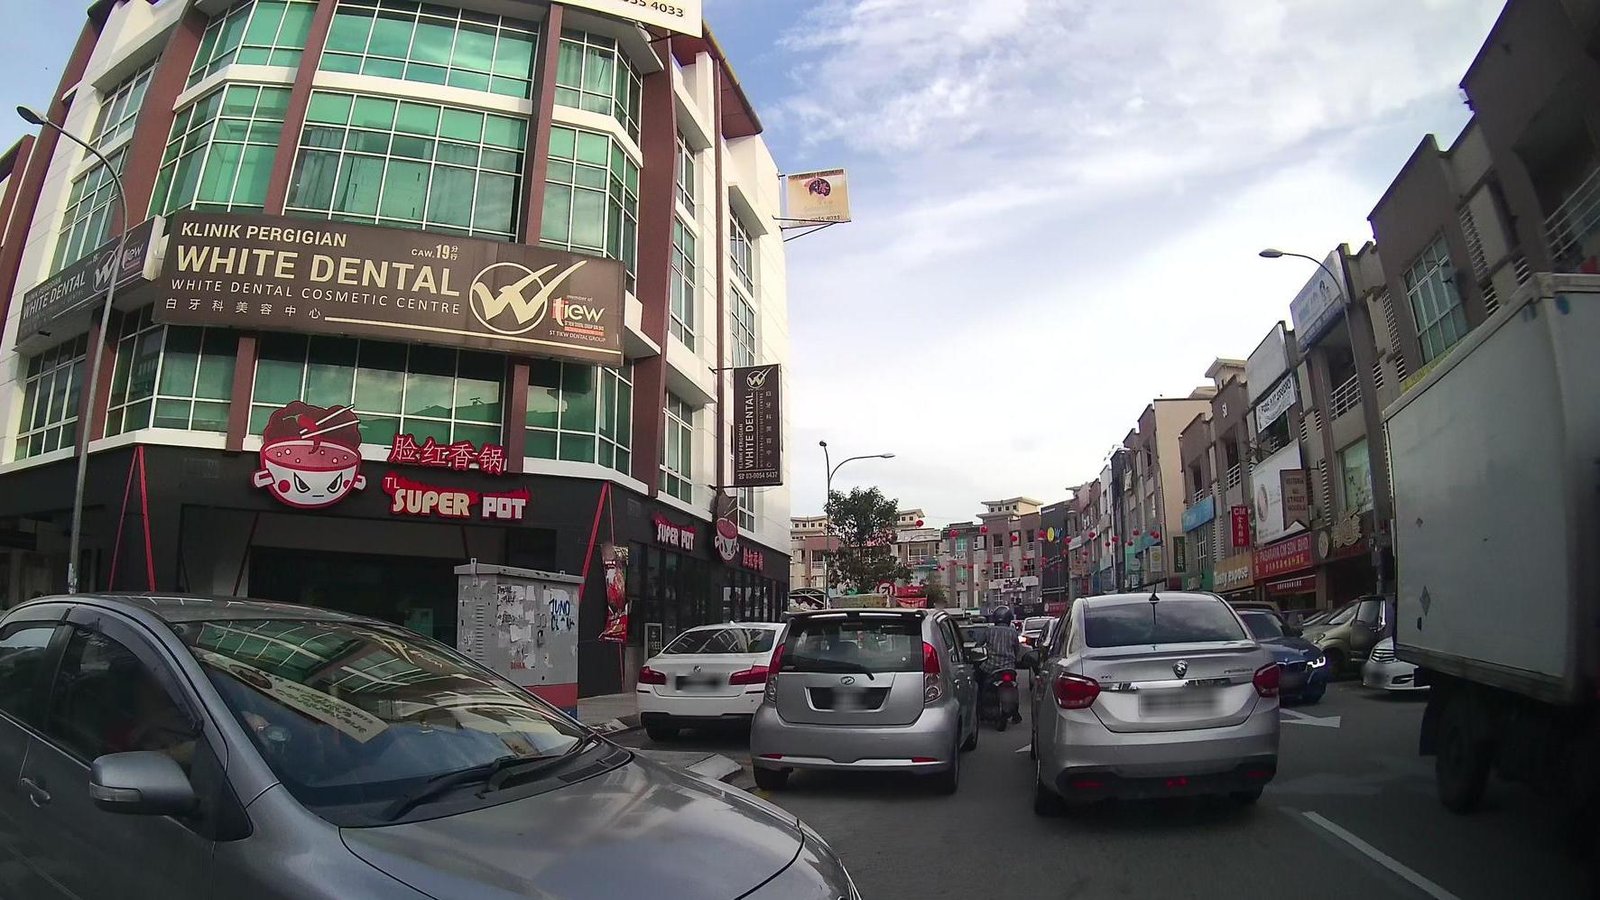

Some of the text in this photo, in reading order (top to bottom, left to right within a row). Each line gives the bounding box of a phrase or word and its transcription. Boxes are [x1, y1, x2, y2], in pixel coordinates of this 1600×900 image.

[651, 1, 684, 18] 4033
[181, 222, 347, 247] KLINIK PERGIGIAN
[177, 245, 460, 297] WHITE DENTAL
[23, 292, 48, 320] WHITE
[50, 270, 86, 303] DENTAL
[165, 298, 321, 319] 白牙科美容中心
[171, 279, 460, 315] WHITE DENTAL COSMETIC CENTRE
[745, 392, 754, 469] WHITE DENTAL
[391, 436, 503, 473] 脸红香锅
[385, 476, 399, 488] TL
[392, 489, 526, 519] SUPER POT
[657, 523, 695, 551] SUPER POT
